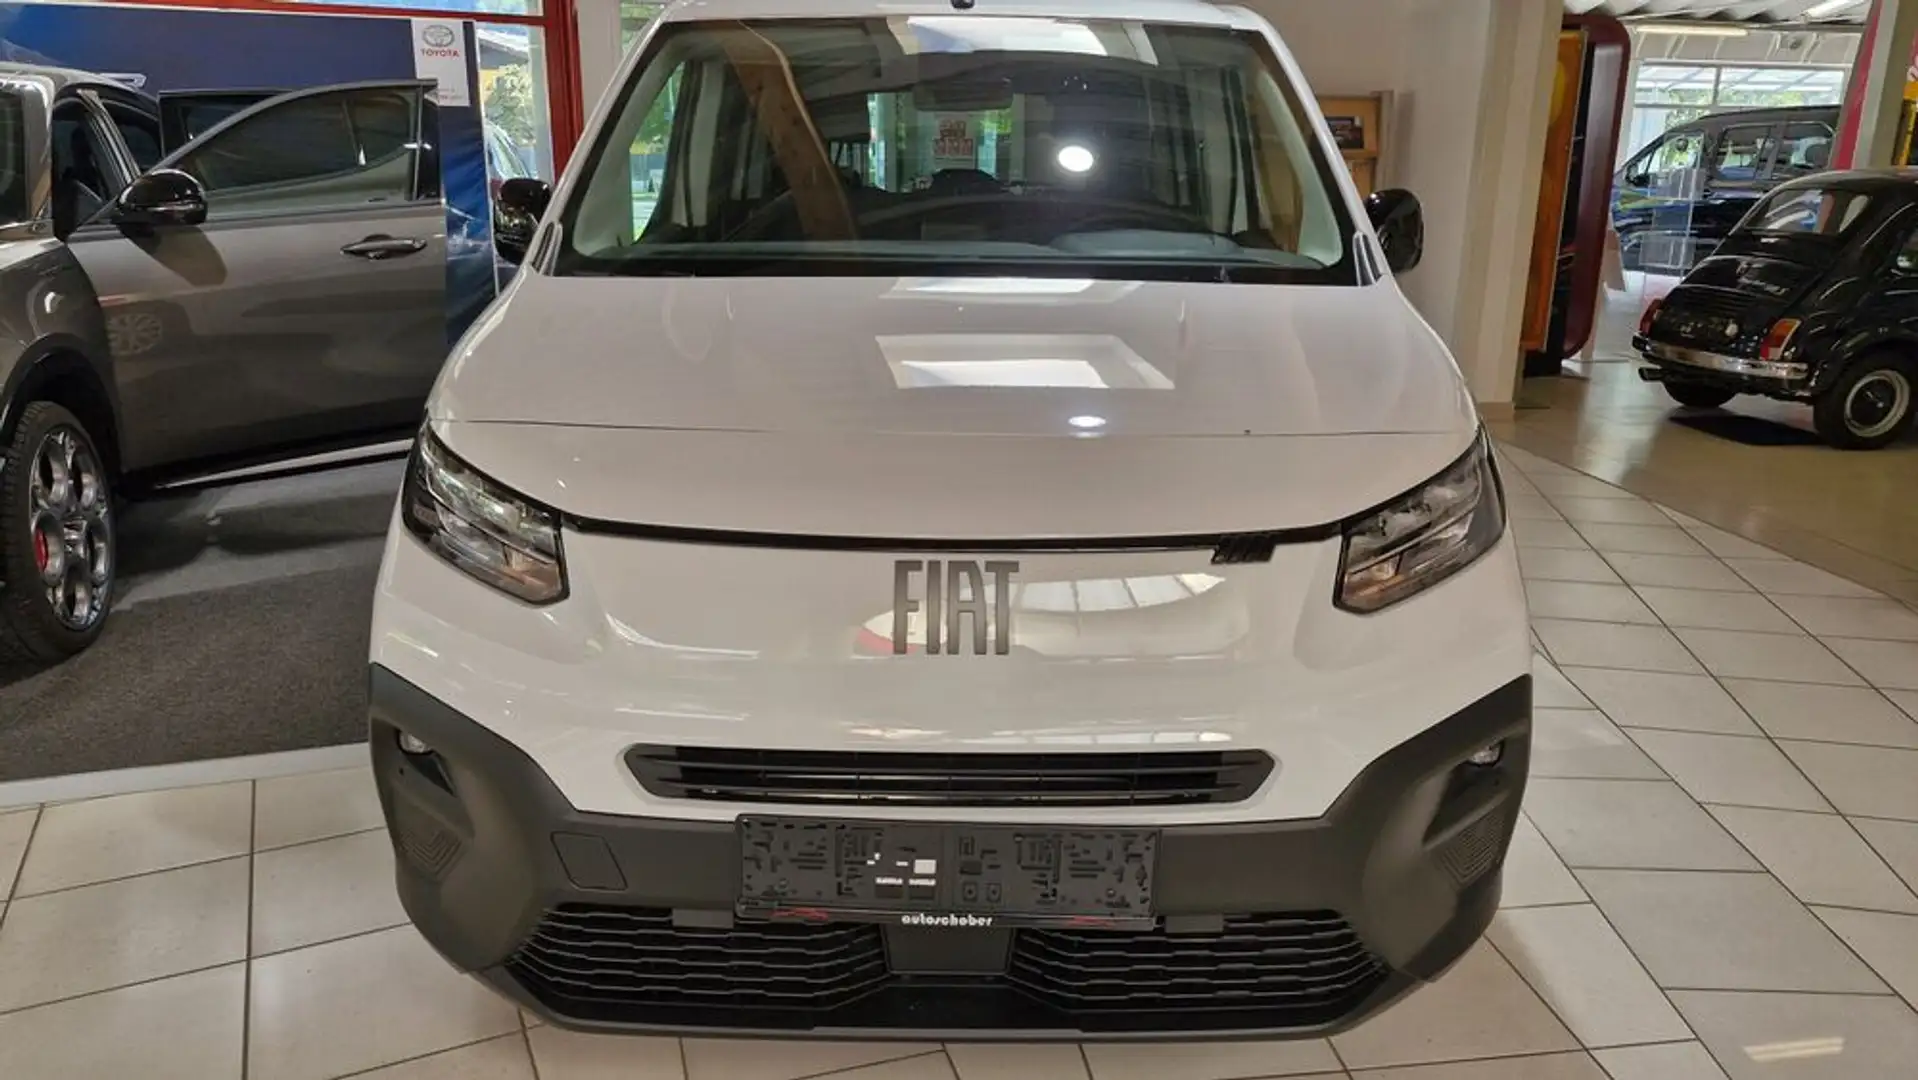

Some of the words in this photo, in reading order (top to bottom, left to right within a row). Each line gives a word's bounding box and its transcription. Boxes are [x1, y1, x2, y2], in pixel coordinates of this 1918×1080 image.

[420, 48, 460, 57] TOYOTA
[893, 560, 1019, 655] FIAT
[901, 912, 993, 926] autoschober
